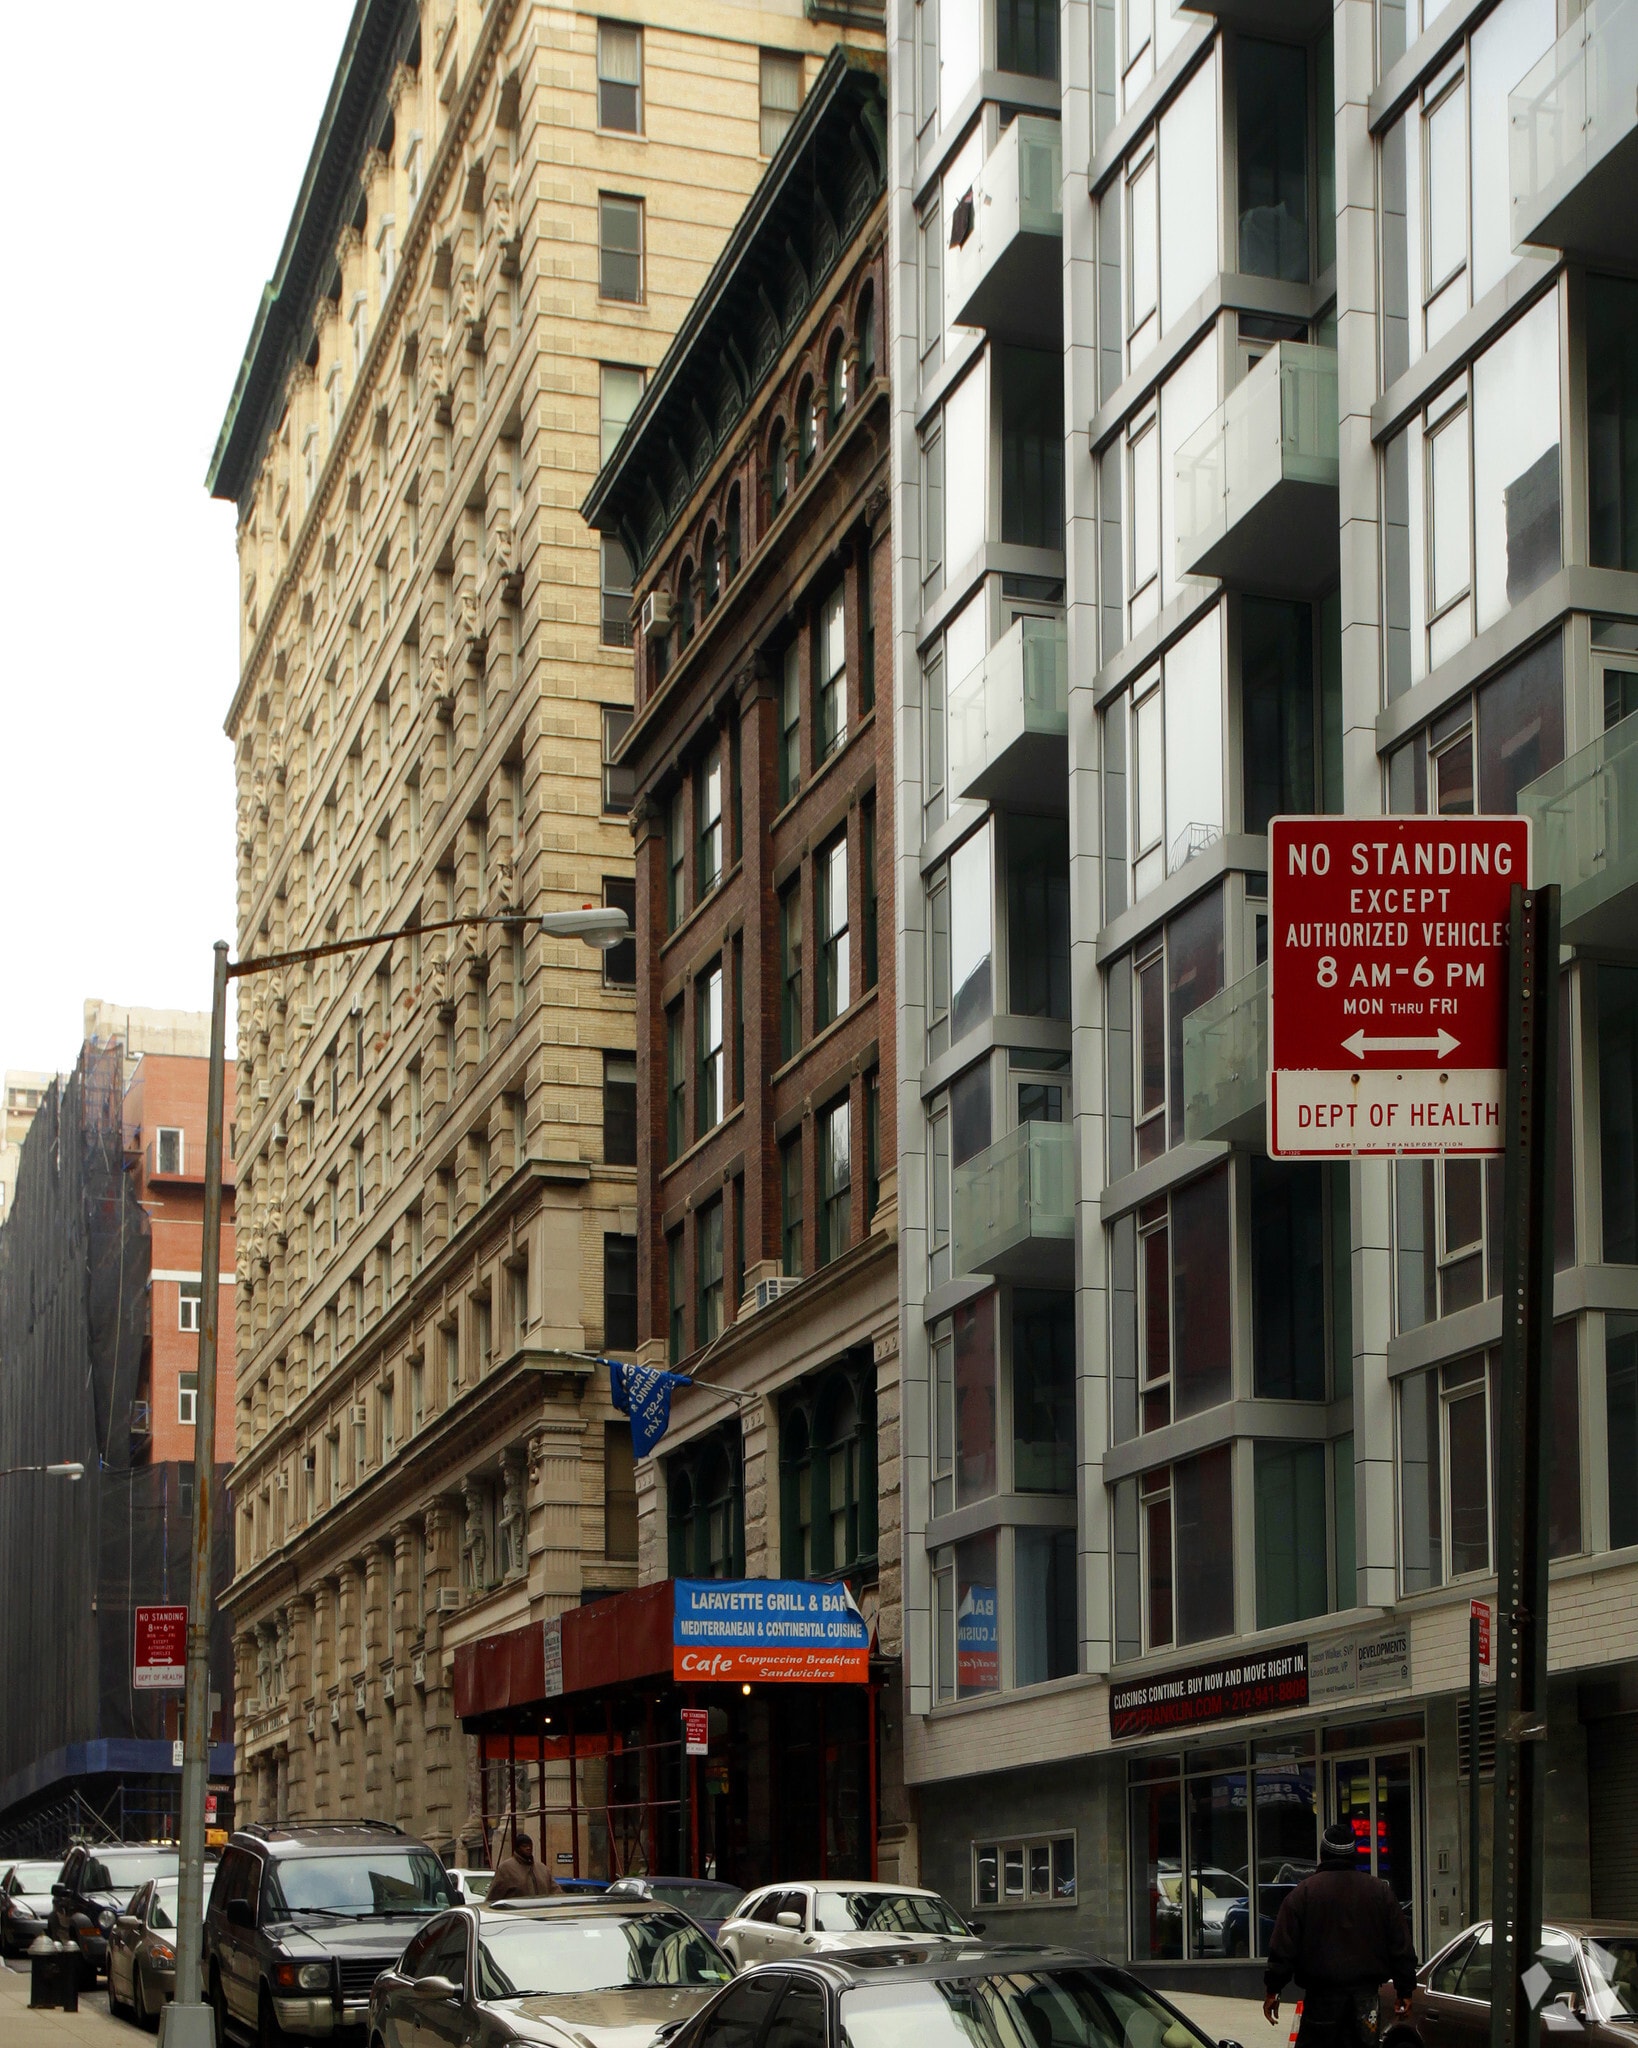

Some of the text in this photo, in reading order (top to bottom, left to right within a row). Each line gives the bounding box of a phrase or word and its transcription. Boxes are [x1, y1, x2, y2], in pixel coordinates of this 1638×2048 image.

[1289, 842, 1512, 875] NO STANDING
[1350, 888, 1450, 913] EXCEPT
[1286, 923, 1408, 947] AUTHORIZED
[1316, 956, 1338, 988] 8
[1447, 963, 1485, 987] PM
[1343, 998, 1458, 1014] MON THRU FRI
[1298, 1102, 1499, 1128] DEPT OF HEALTH
[644, 1416, 662, 1437] FAX
[691, 1592, 763, 1610] LAFAYETTE
[767, 1594, 805, 1611] GRILL
[809, 1595, 818, 1611] &
[140, 1612, 184, 1621] NO STANDING
[681, 1620, 862, 1638] MEDITERRANEAN & CONTINENTAL CUISINE
[738, 1654, 860, 1666] Cappuccino Breakfast
[1358, 1639, 1407, 1660] DEVELOPMENTS
[681, 1653, 733, 1676] Cafe
[759, 1668, 835, 1678] Sandwiches
[153, 1673, 160, 1681] OF
[1114, 1655, 1306, 1710] CLOSINGS CONTINUE. BUY NOW AND MOVE RIGHT IN.
